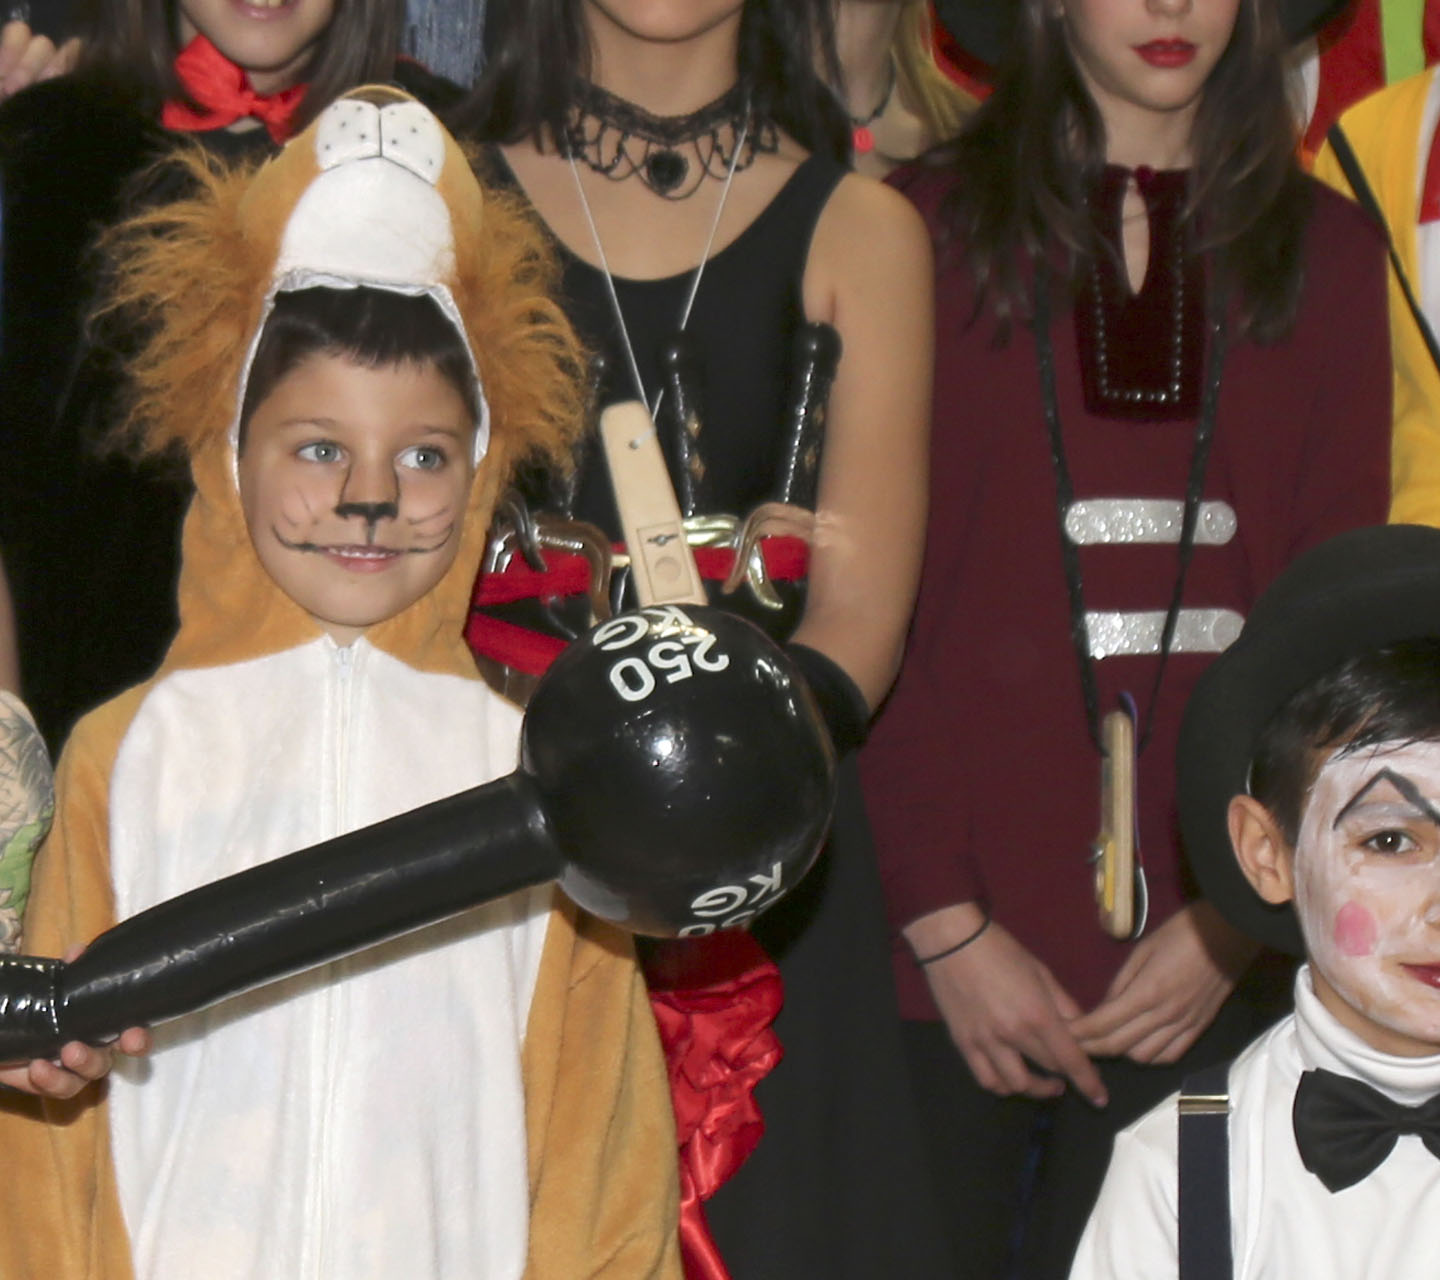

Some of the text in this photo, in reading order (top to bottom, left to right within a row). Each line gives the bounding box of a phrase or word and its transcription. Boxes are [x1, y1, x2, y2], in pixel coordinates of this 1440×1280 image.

[592, 605, 694, 650] KG
[609, 632, 730, 702] 250
[691, 862, 782, 917] KG
